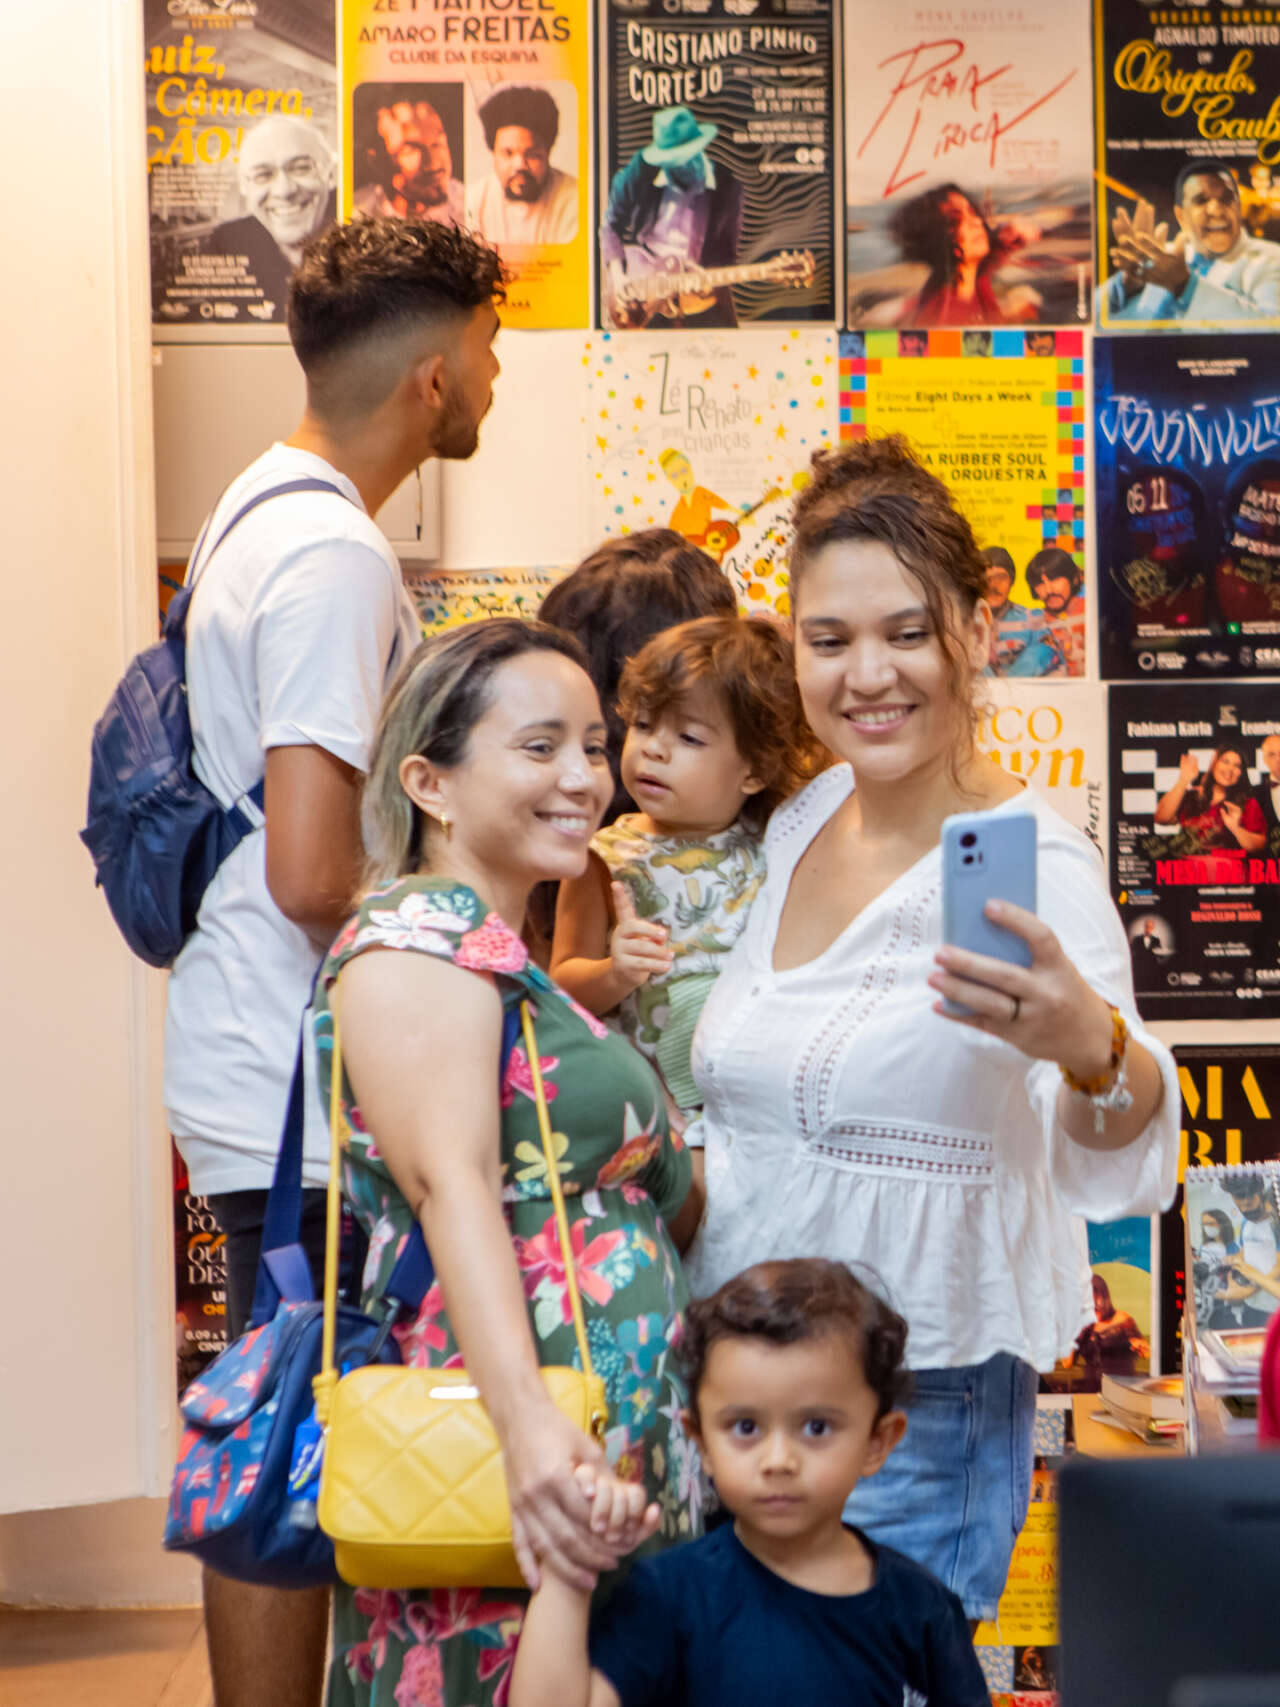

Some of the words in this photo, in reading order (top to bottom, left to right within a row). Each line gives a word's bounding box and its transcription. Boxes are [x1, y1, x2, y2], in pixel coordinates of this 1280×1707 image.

[359, 26, 436, 43] AMARO
[444, 16, 571, 43] FREITAS
[627, 20, 744, 65] CRISTIANO
[750, 26, 818, 54] PINHO
[145, 35, 226, 81] uiz,
[389, 50, 440, 64] CLUBE
[445, 50, 465, 64] DA
[471, 50, 539, 64] ESQUINA
[156, 77, 313, 119] Câmera,
[629, 65, 723, 105] CORTEJO
[916, 391, 948, 404] Eight
[953, 390, 982, 404] Days
[998, 391, 1032, 402] Week
[938, 453, 1001, 465] RUBBER
[1007, 453, 1047, 465] SOUL
[951, 468, 1047, 481] ORQUESTRA
[975, 705, 1064, 745] ICO
